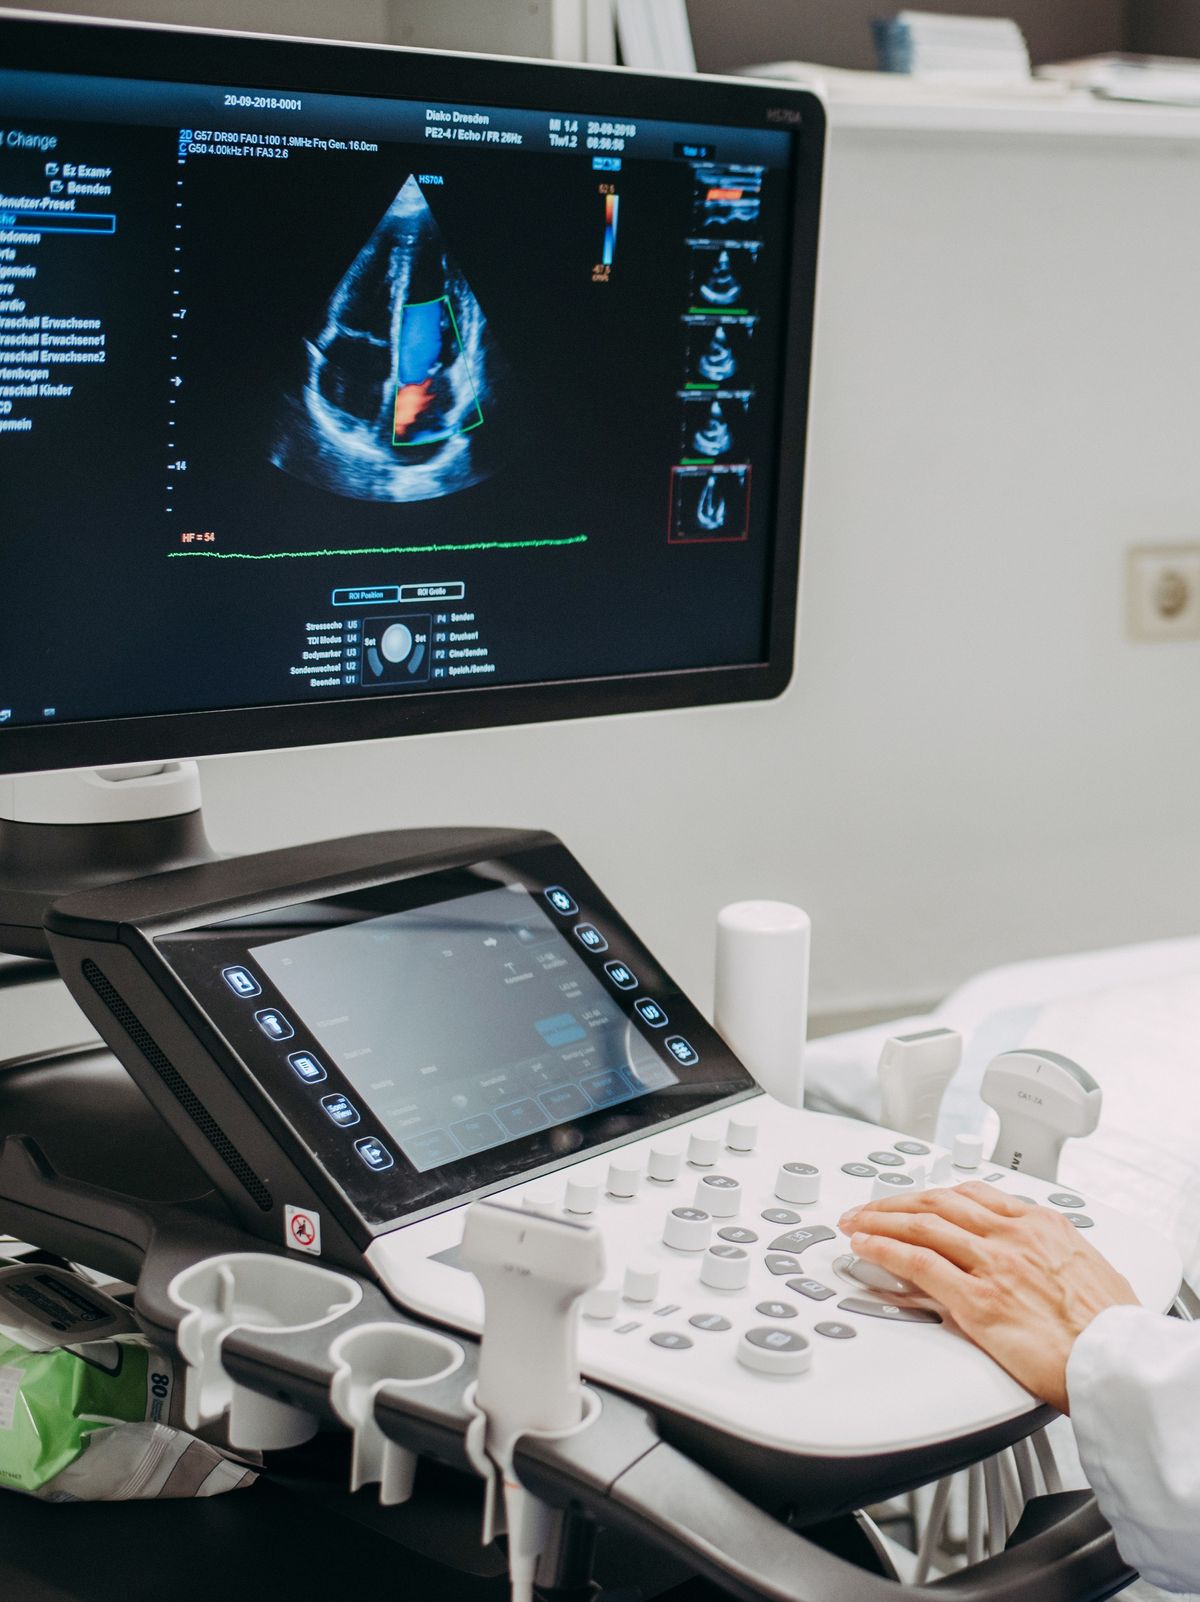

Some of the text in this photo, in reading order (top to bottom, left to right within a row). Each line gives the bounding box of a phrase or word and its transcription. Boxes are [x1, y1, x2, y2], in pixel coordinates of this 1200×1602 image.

[224, 94, 302, 110] 20-09-2018-0001
[425, 110, 490, 125] Diako Dresden
[7, 130, 58, 152] Change
[179, 129, 193, 141] 2D
[194, 130, 212, 141] G57
[214, 131, 239, 143] DR90
[282, 136, 312, 148] 1.9MHz
[313, 138, 327, 151] Frq
[328, 139, 348, 151] Gen.
[349, 140, 378, 152] 16.0cm
[425, 127, 451, 139] PE2-4
[457, 129, 480, 142] Echo
[487, 131, 499, 143] FR
[188, 143, 207, 154] G50
[243, 146, 255, 157] F1
[275, 147, 289, 159] 2.6
[419, 174, 444, 186] HS70A
[67, 181, 111, 195] Beenden
[0, 316, 101, 330] raschall Erwachsene
[0, 333, 106, 347] raschall Erwachsene1
[0, 350, 106, 364] raschall Erwachsene2
[0, 384, 74, 397] raschall Kinder
[176, 460, 187, 471] 14
[181, 532, 195, 543] HF
[204, 532, 215, 543] 54
[361, 590, 384, 600] Position
[364, 637, 377, 646] Set
[415, 634, 427, 643] Set
[302, 649, 342, 661] Bodymarker
[151, 1373, 170, 1398] 80
